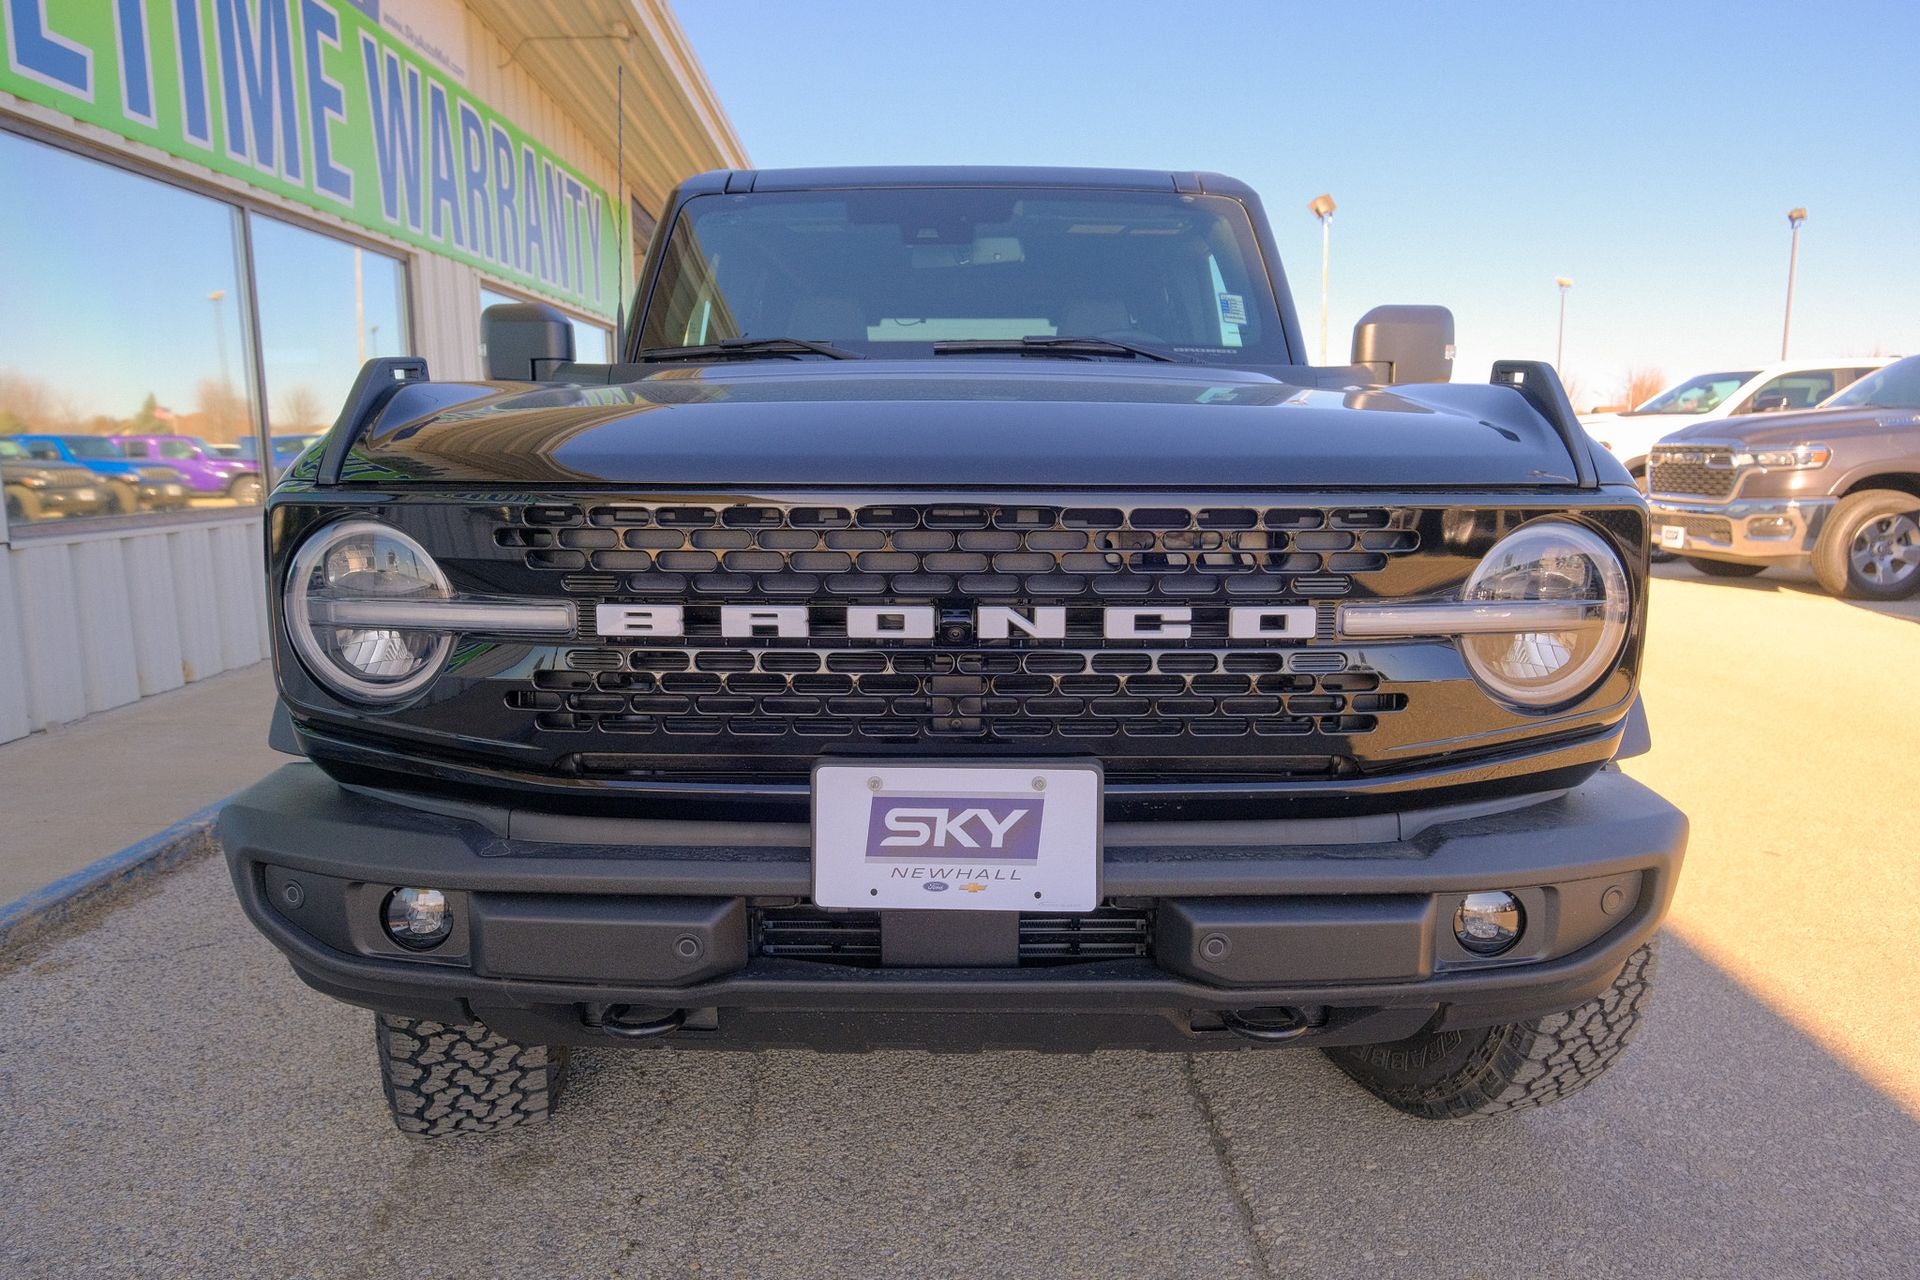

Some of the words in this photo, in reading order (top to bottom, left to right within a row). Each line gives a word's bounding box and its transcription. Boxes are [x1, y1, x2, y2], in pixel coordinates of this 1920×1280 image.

[357, 26, 602, 305] WARRANTY
[597, 603, 1318, 640] BRONCO
[879, 807, 1030, 848] SKY
[890, 867, 1022, 881] NEWHALL
